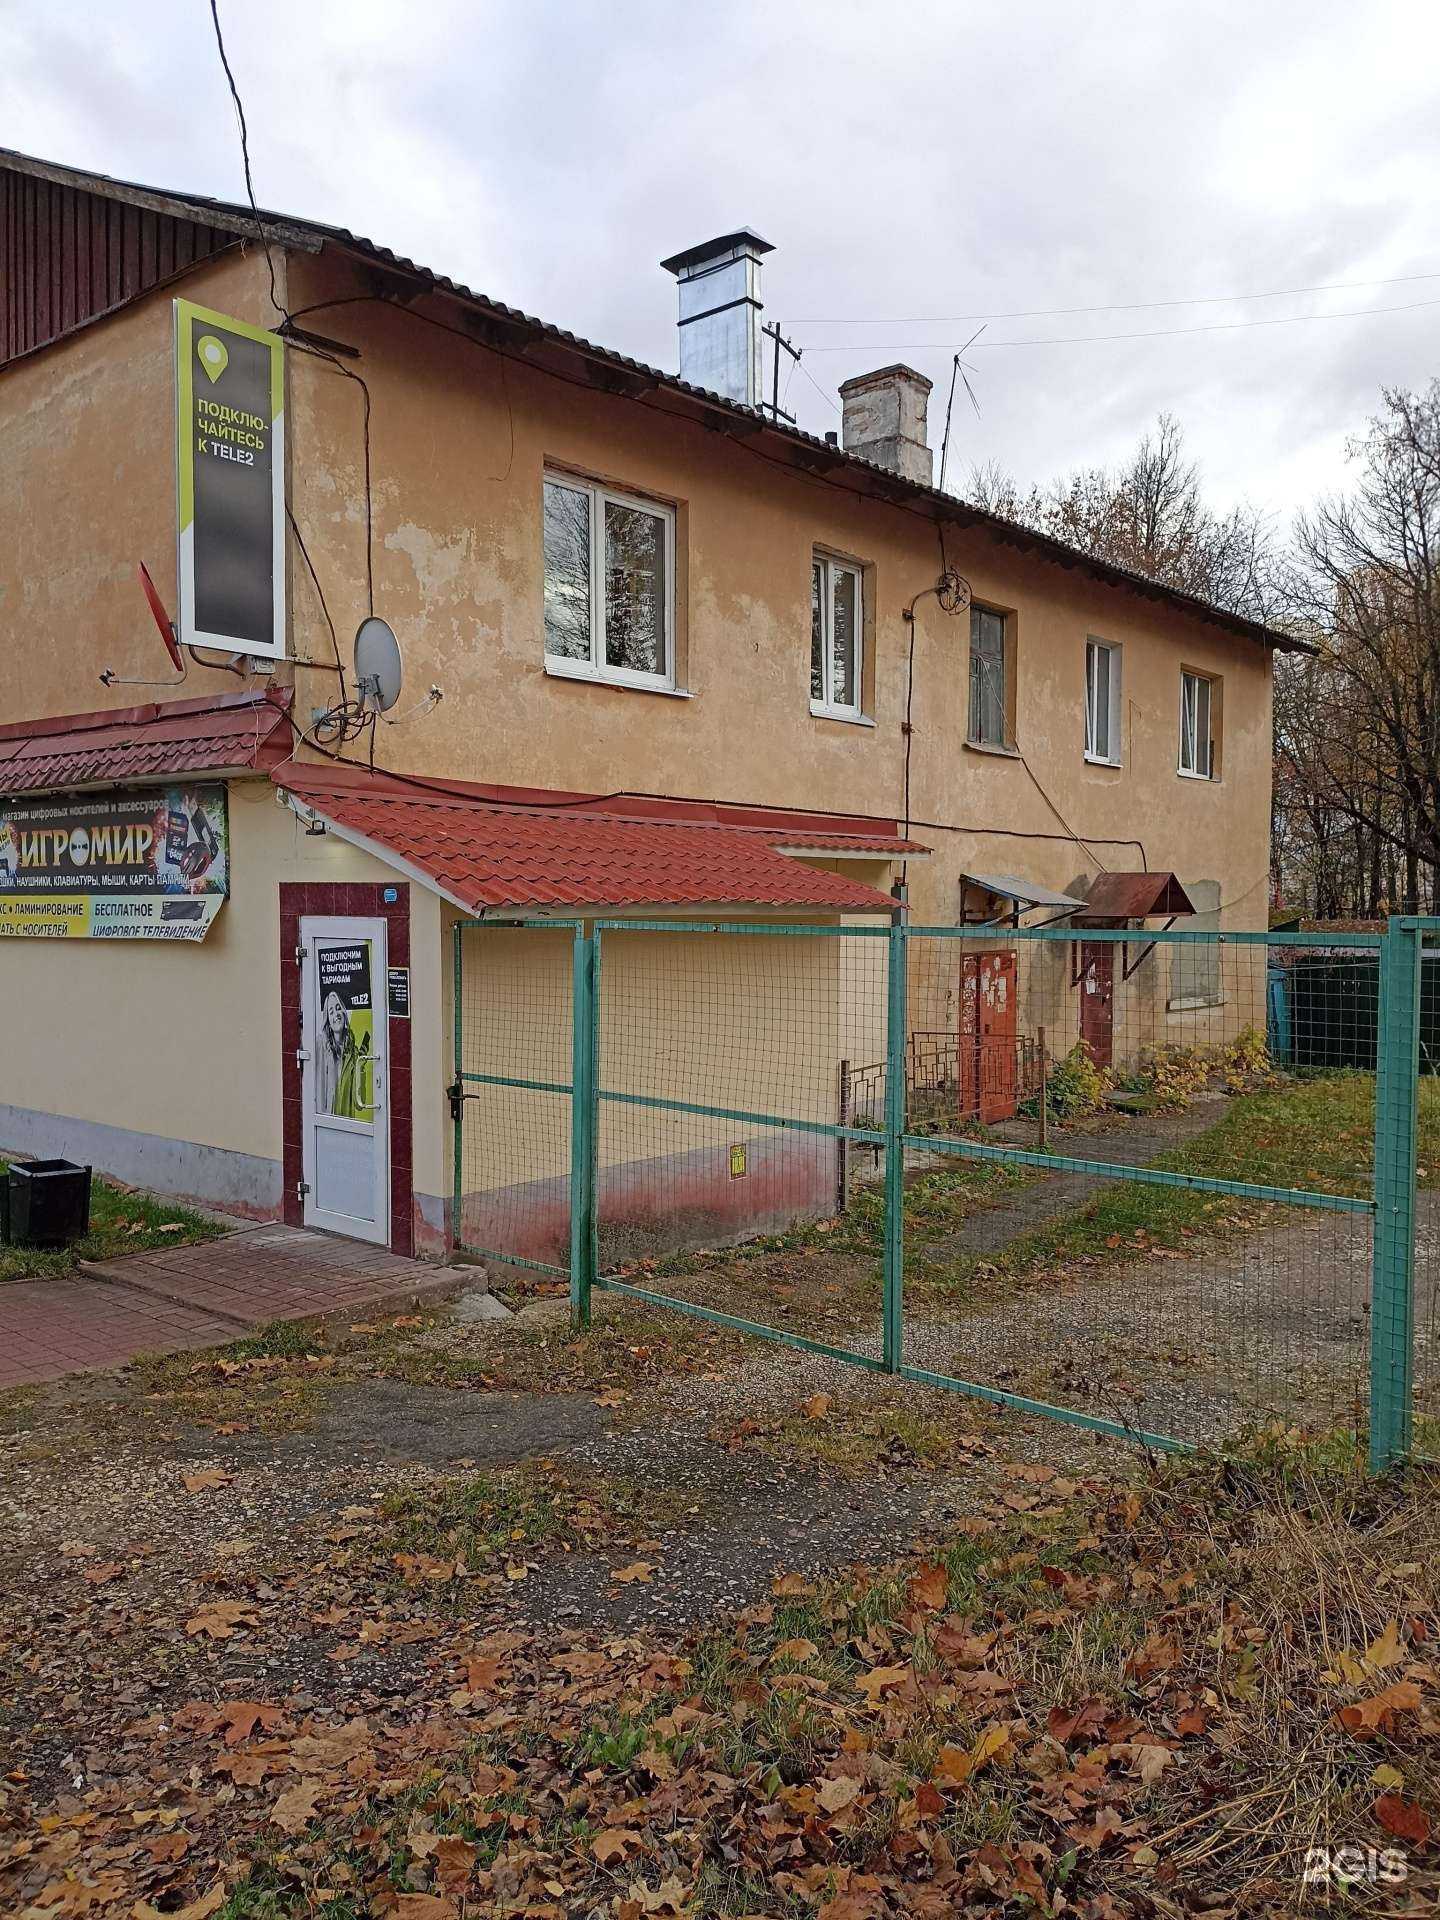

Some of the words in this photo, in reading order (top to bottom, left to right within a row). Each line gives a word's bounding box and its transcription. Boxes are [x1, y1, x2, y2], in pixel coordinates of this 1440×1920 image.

[198, 398, 269, 431] ПОДКЛЮ-
[198, 418, 264, 450] ЧАЙТЕСЬ
[198, 437, 208, 453] К
[211, 441, 254, 466] TELE2
[30, 808, 68, 821] цифровых
[20, 824, 153, 868] ИГРОМИР
[129, 874, 156, 886] КАРТЫ
[15, 903, 84, 916] ЛАМИНИРОВАНИЕ
[95, 903, 153, 917] БЕСПЛАТНОЕ
[22, 921, 69, 937] НОСИТЕЛЕЙ
[93, 925, 141, 937] ЦИФРОВОЕ
[143, 925, 208, 939] ТЕЛЕВИДЕНИЕ
[320, 951, 361, 962] ПОДКЛЮЧИМ
[326, 962, 362, 972] ВЫГОДНЫМ
[322, 975, 350, 984] ТАРИФАМ
[351, 993, 369, 1005] TELE2
